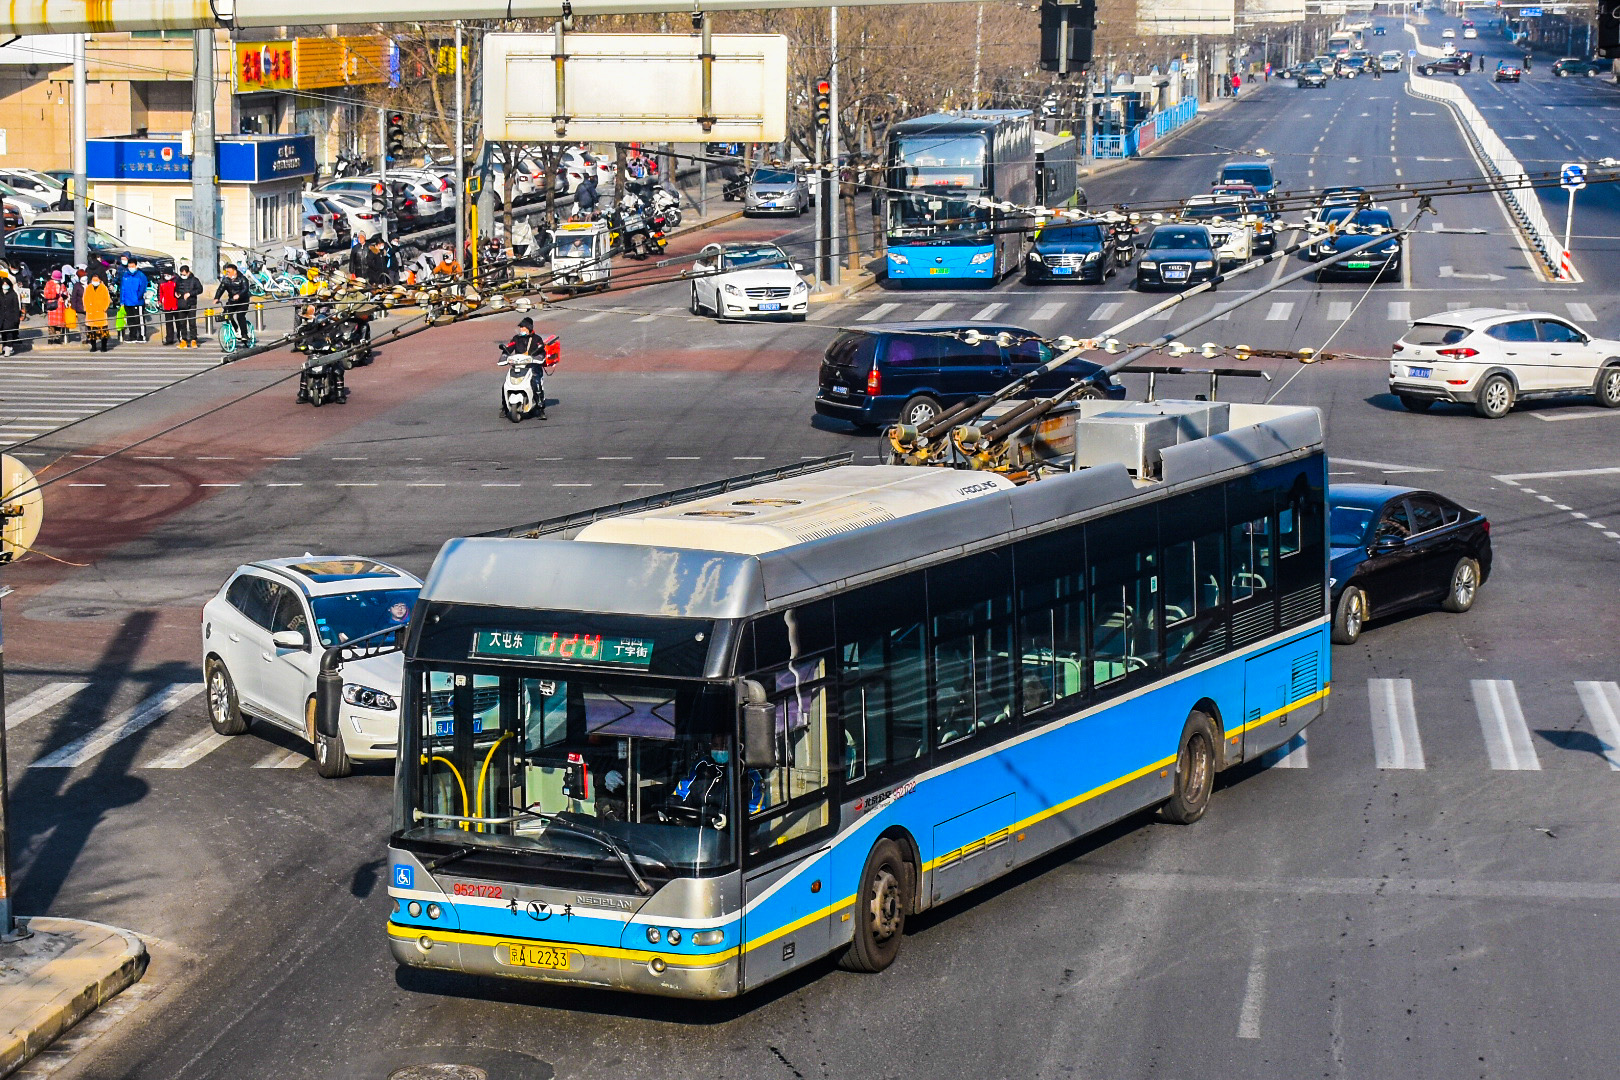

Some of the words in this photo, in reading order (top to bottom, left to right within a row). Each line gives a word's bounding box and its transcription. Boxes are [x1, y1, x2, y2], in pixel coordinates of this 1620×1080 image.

[613, 645, 648, 658] 丁字街
[453, 882, 502, 899] 9521722
